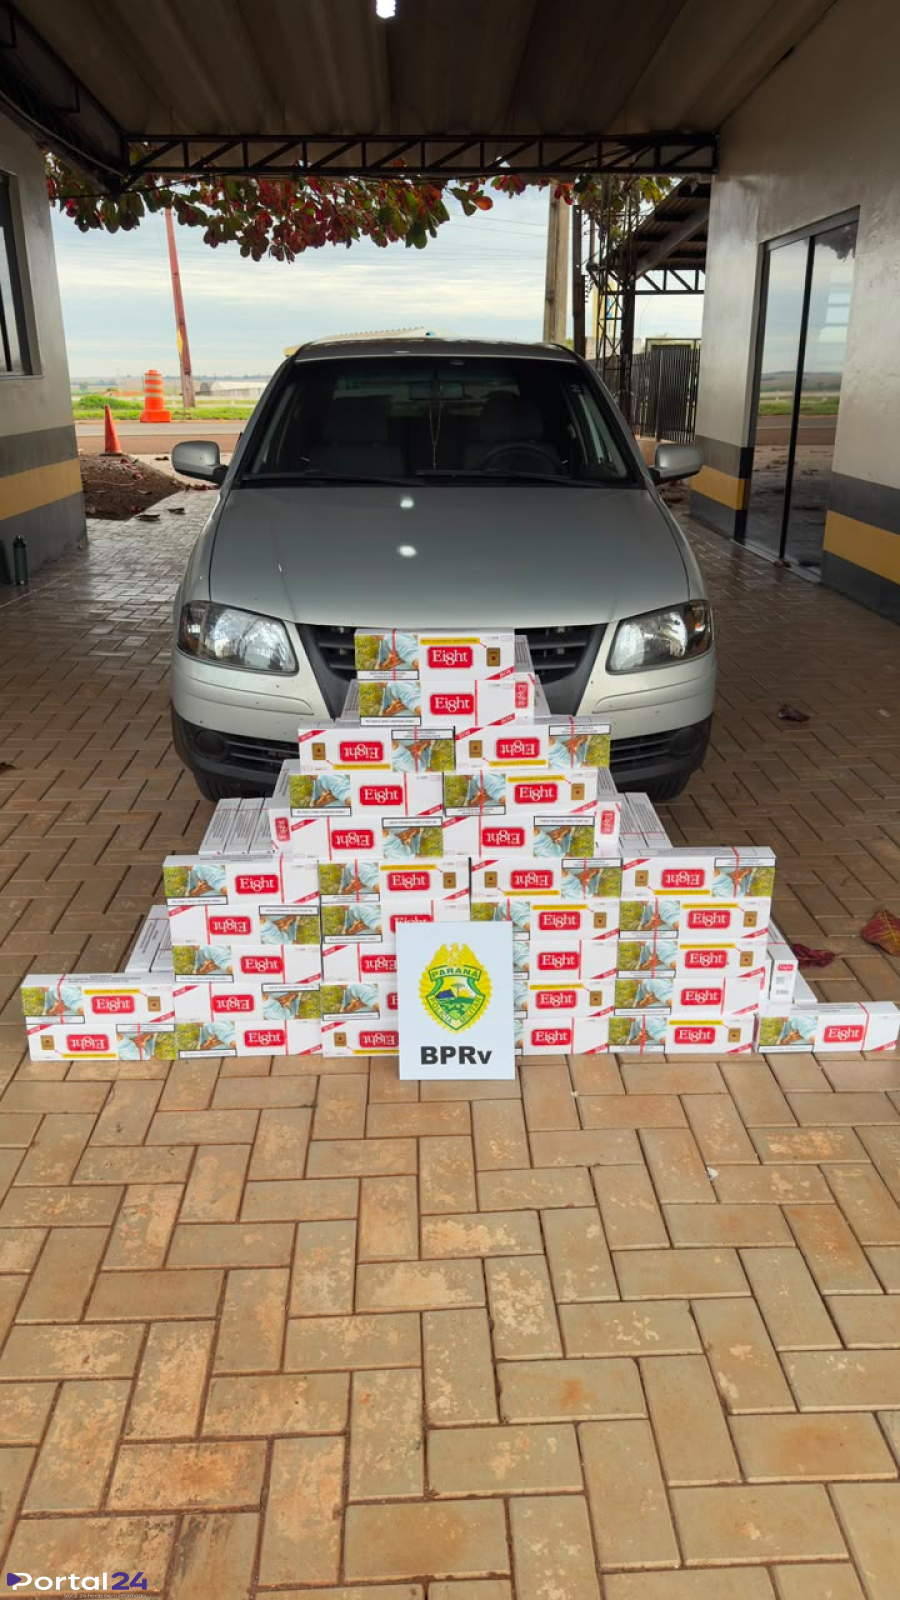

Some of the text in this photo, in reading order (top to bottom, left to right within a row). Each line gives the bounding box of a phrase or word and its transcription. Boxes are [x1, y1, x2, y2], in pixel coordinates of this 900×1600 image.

[433, 649, 468, 666] Eight
[434, 697, 471, 712] Eight
[344, 745, 379, 760] Eight
[501, 740, 535, 756] Eight
[364, 787, 399, 802] Eight
[519, 786, 553, 801] Eight
[336, 833, 370, 847] Eight
[487, 831, 520, 845] Eight
[239, 877, 274, 891] Eight
[392, 874, 426, 888] Eight
[515, 872, 549, 886] Eight
[666, 872, 701, 886] Eight
[214, 919, 248, 933] Eight
[543, 914, 576, 928] Eight
[692, 912, 726, 926] Eight
[244, 958, 278, 971] Eight
[542, 954, 575, 968] Eight
[689, 952, 723, 966] Eight
[217, 997, 250, 1010] Eight
[540, 993, 573, 1007] Eight
[684, 991, 718, 1003] Eight
[96, 998, 131, 1011] Eight
[421, 1046, 492, 1065] BPRv
